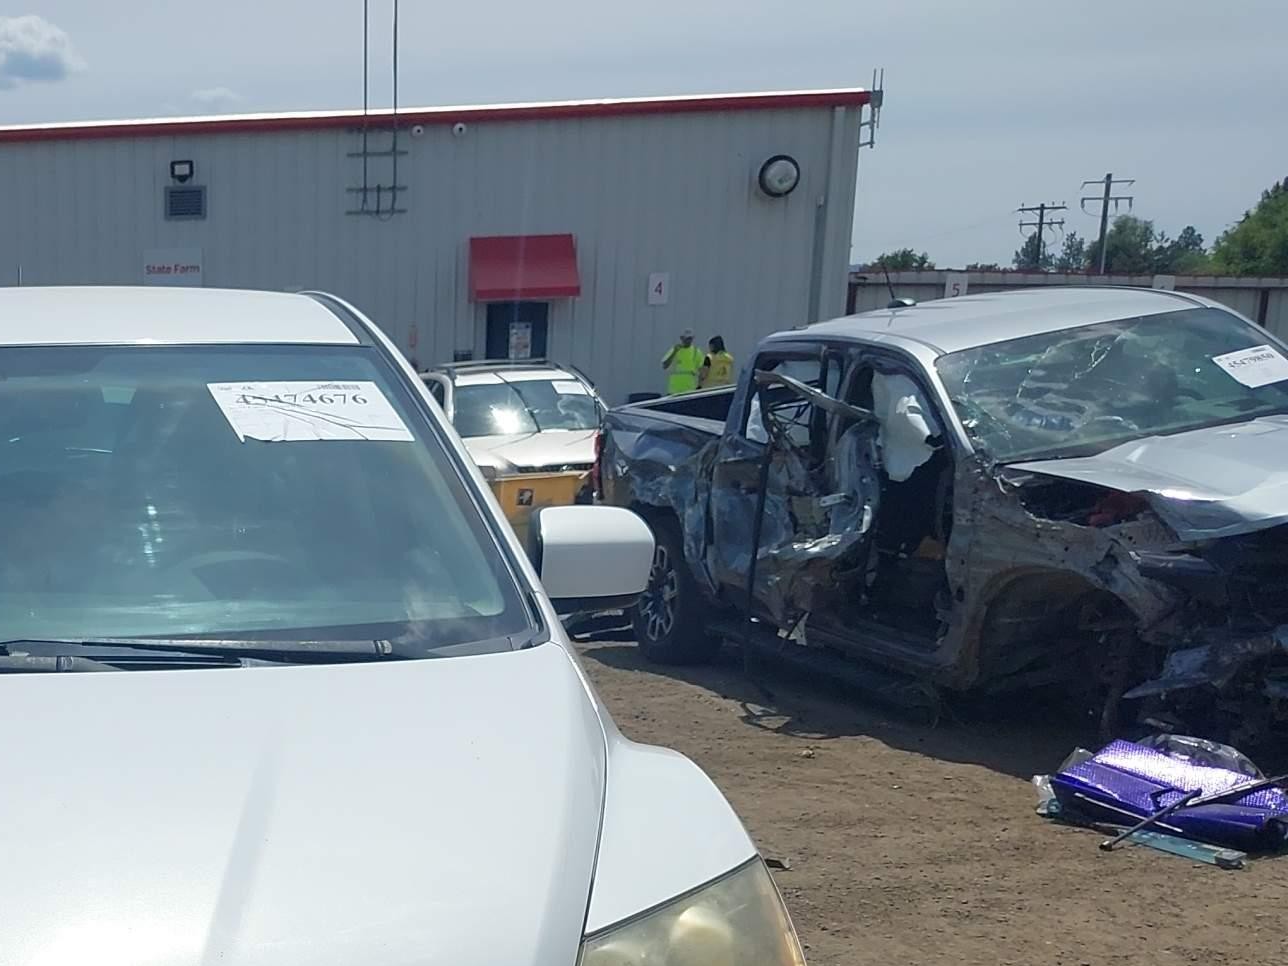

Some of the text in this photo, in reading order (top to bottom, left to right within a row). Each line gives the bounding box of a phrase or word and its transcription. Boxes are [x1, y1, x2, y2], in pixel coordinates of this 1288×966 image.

[145, 264, 200, 274] State Farm
[654, 281, 663, 296] 4
[952, 283, 961, 297] 5
